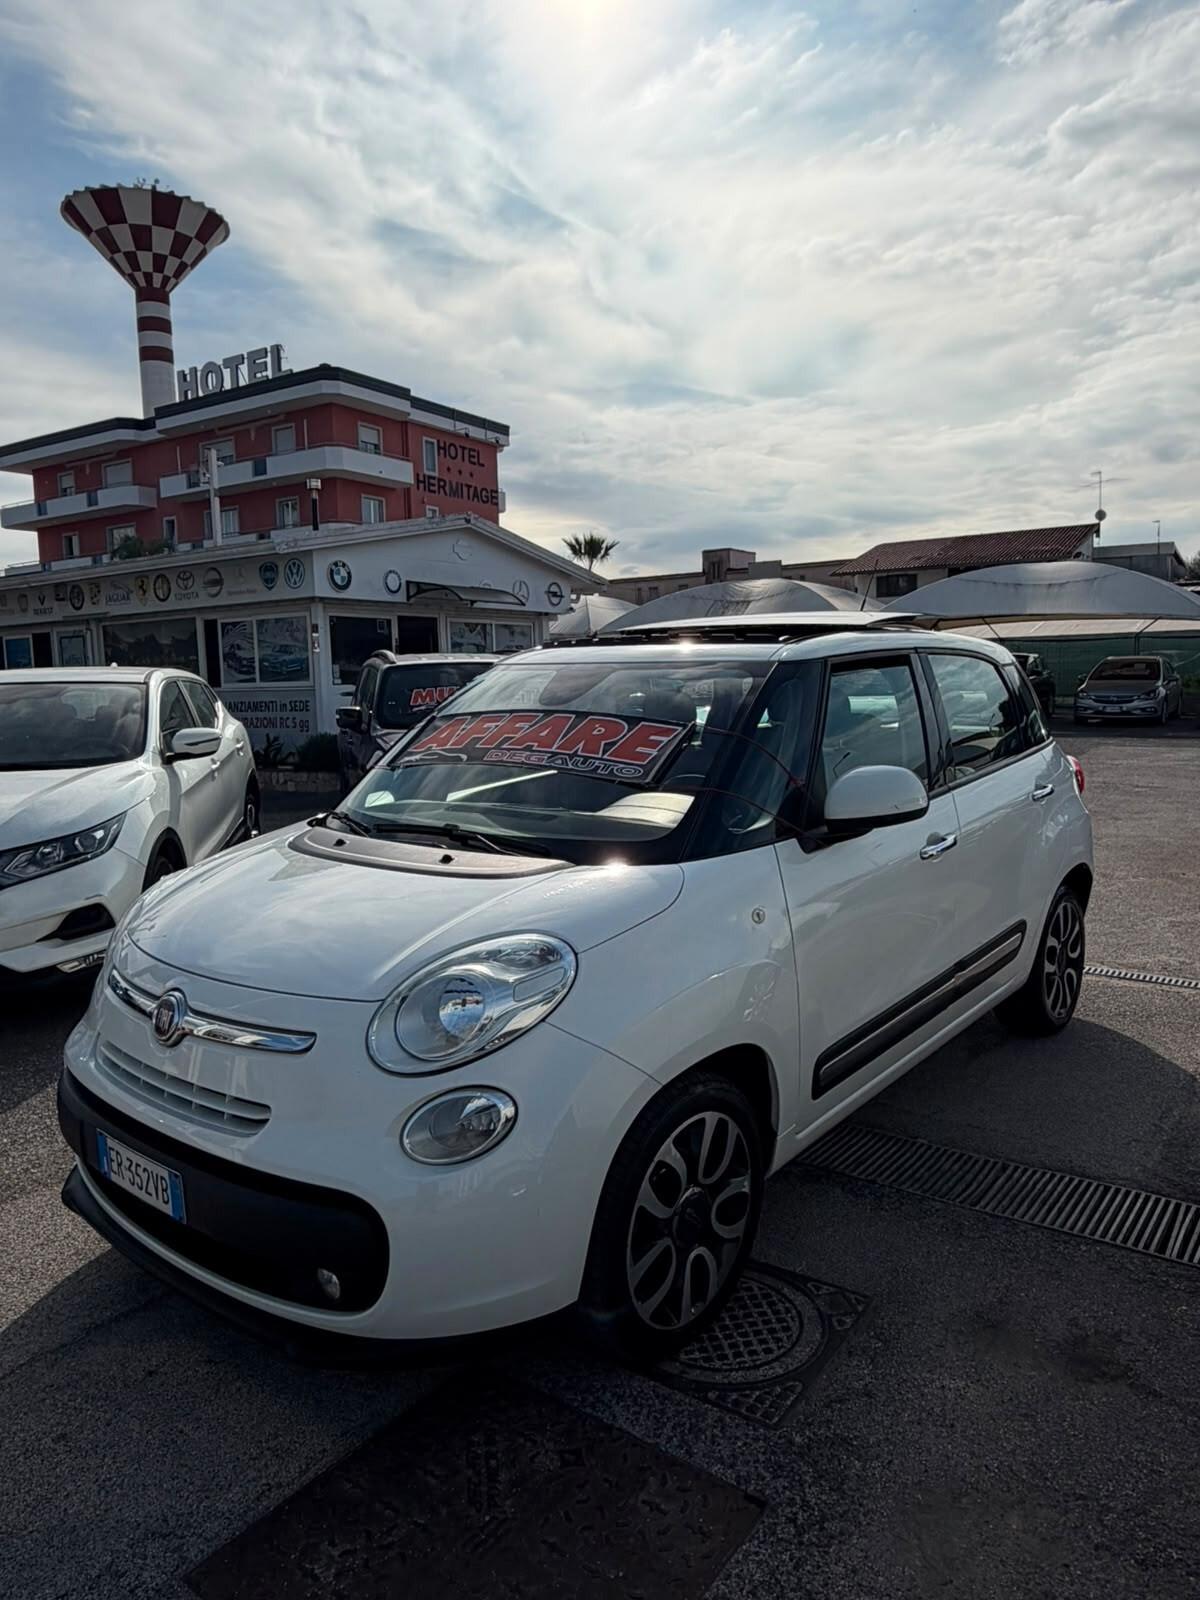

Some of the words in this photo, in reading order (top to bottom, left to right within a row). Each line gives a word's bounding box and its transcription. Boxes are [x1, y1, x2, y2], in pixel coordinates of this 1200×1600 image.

[177, 344, 293, 402] HOTEL
[437, 439, 485, 468] HOTEL
[416, 472, 498, 506] HERMITAGE
[174, 591, 200, 601] TOYOTA
[279, 700, 287, 712] in
[289, 699, 310, 712] SEDE
[280, 716, 290, 729] RC
[299, 719, 310, 732] gg
[412, 712, 683, 764] AFFARE
